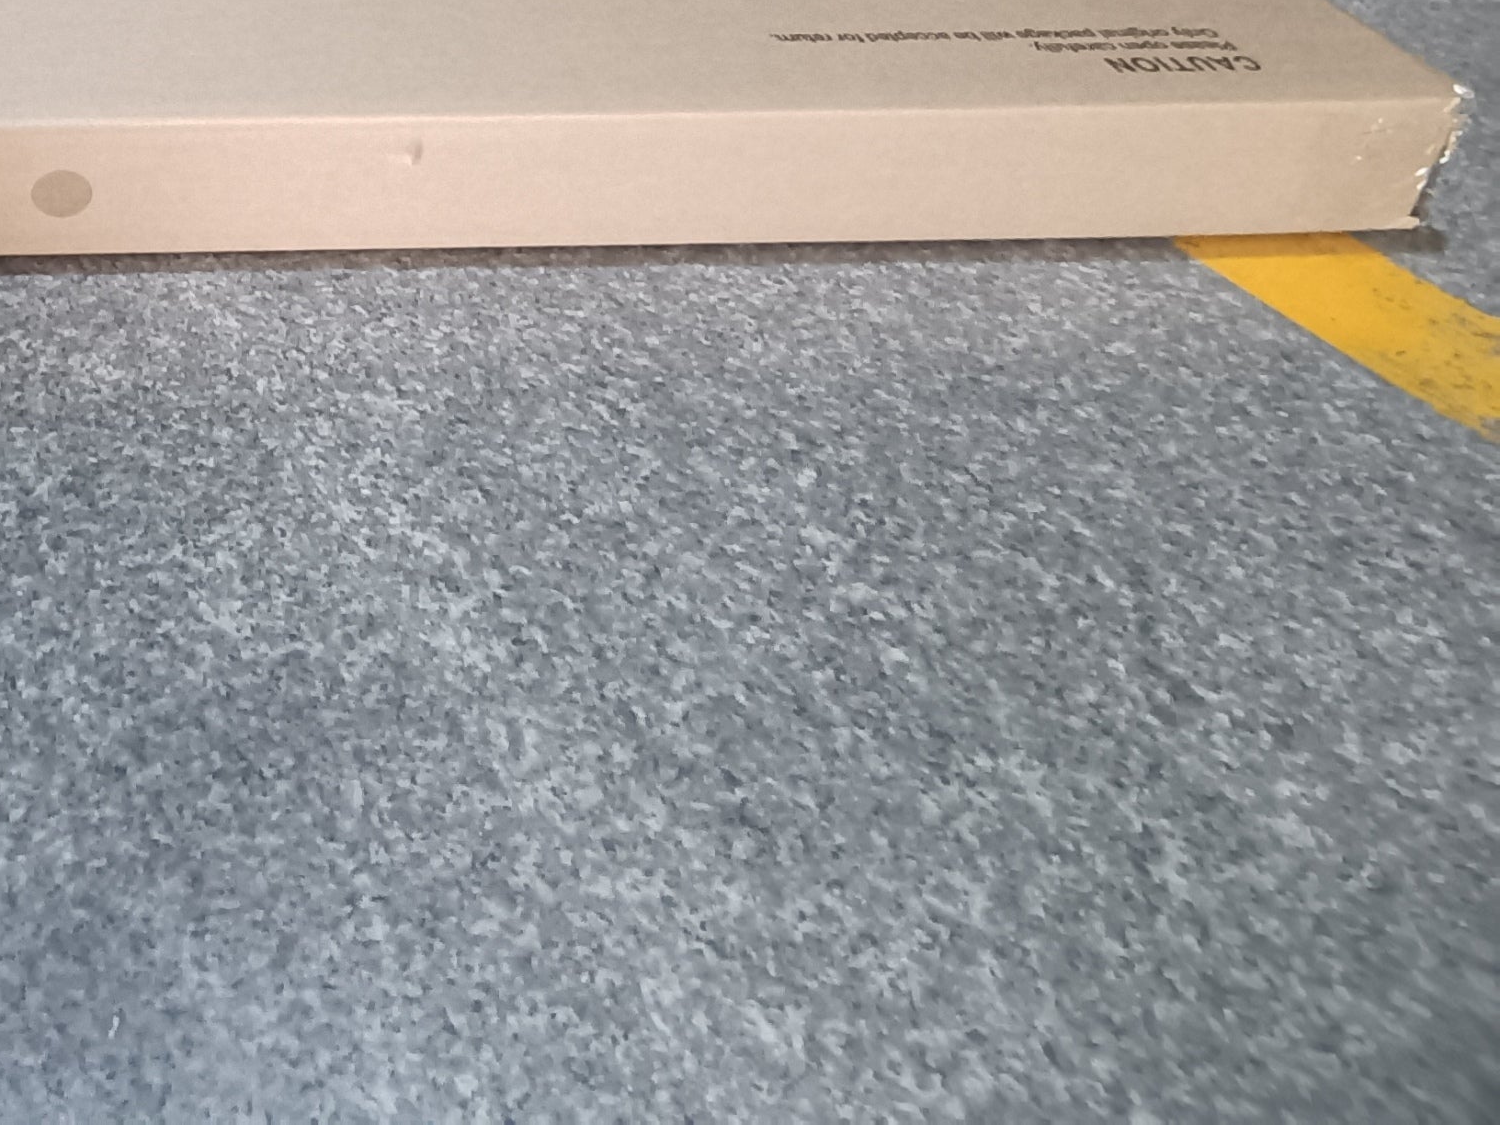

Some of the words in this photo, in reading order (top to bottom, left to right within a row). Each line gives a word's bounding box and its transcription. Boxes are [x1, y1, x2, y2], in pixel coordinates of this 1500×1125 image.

[770, 33, 832, 43] return.
[864, 30, 951, 43] accepted
[954, 32, 980, 42] be
[980, 32, 1015, 42] will
[1016, 28, 1096, 40] package
[1098, 28, 1169, 39] original
[1171, 27, 1219, 38] Only
[837, 33, 864, 44] for
[1029, 42, 1117, 53] carefully.
[1118, 41, 1169, 50] open
[1170, 41, 1238, 51] Please
[1104, 56, 1261, 73] CAUTION
